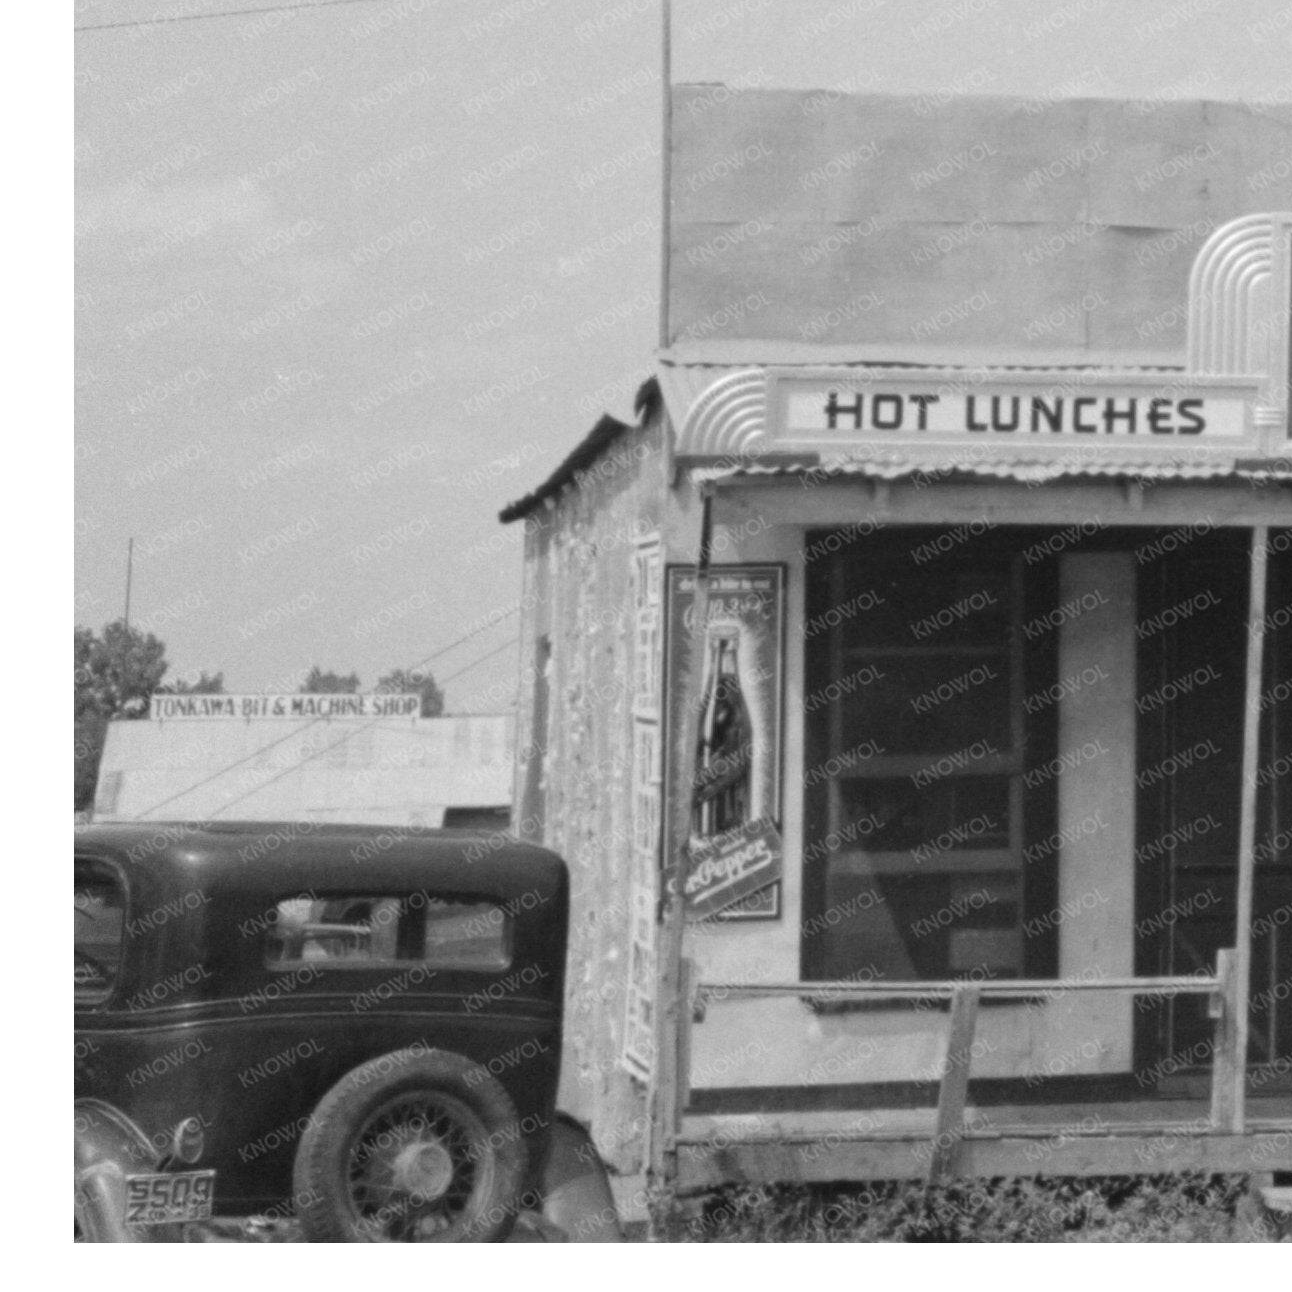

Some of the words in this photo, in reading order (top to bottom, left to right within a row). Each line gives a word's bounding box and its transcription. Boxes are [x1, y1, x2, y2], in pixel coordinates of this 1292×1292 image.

[823, 392, 940, 431] HOT
[964, 394, 1207, 436] LUNCHES
[154, 696, 235, 717] TONKAWA
[241, 697, 268, 717] BIT
[273, 697, 286, 715] &
[291, 697, 365, 717] MACHINE
[372, 696, 419, 717] SHOP
